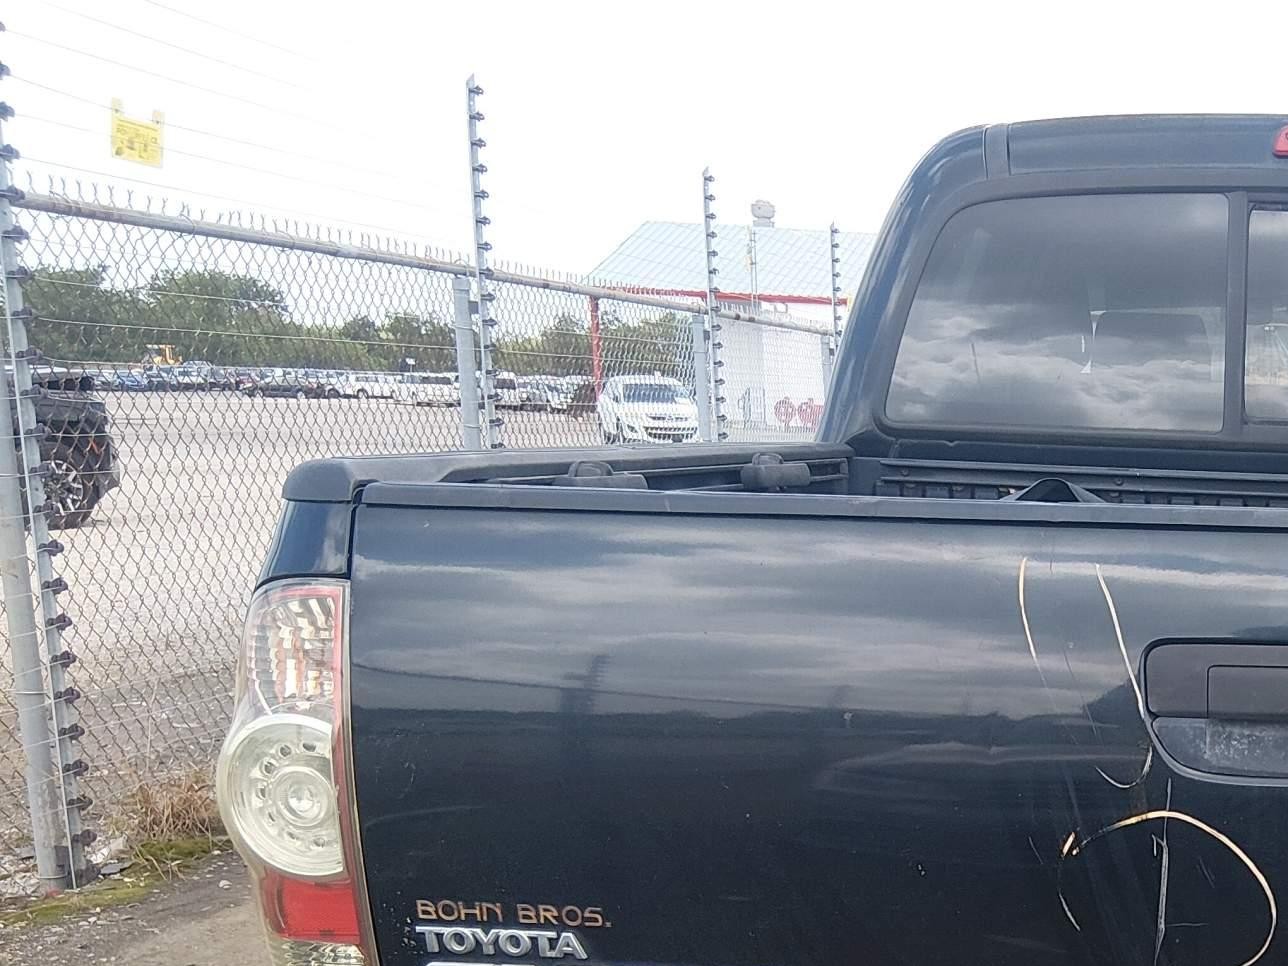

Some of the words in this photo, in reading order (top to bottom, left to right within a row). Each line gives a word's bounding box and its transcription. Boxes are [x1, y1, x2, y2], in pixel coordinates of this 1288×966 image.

[415, 899, 503, 923] BOHN
[517, 903, 613, 928] BROS.
[415, 925, 588, 960] TOYOTA
